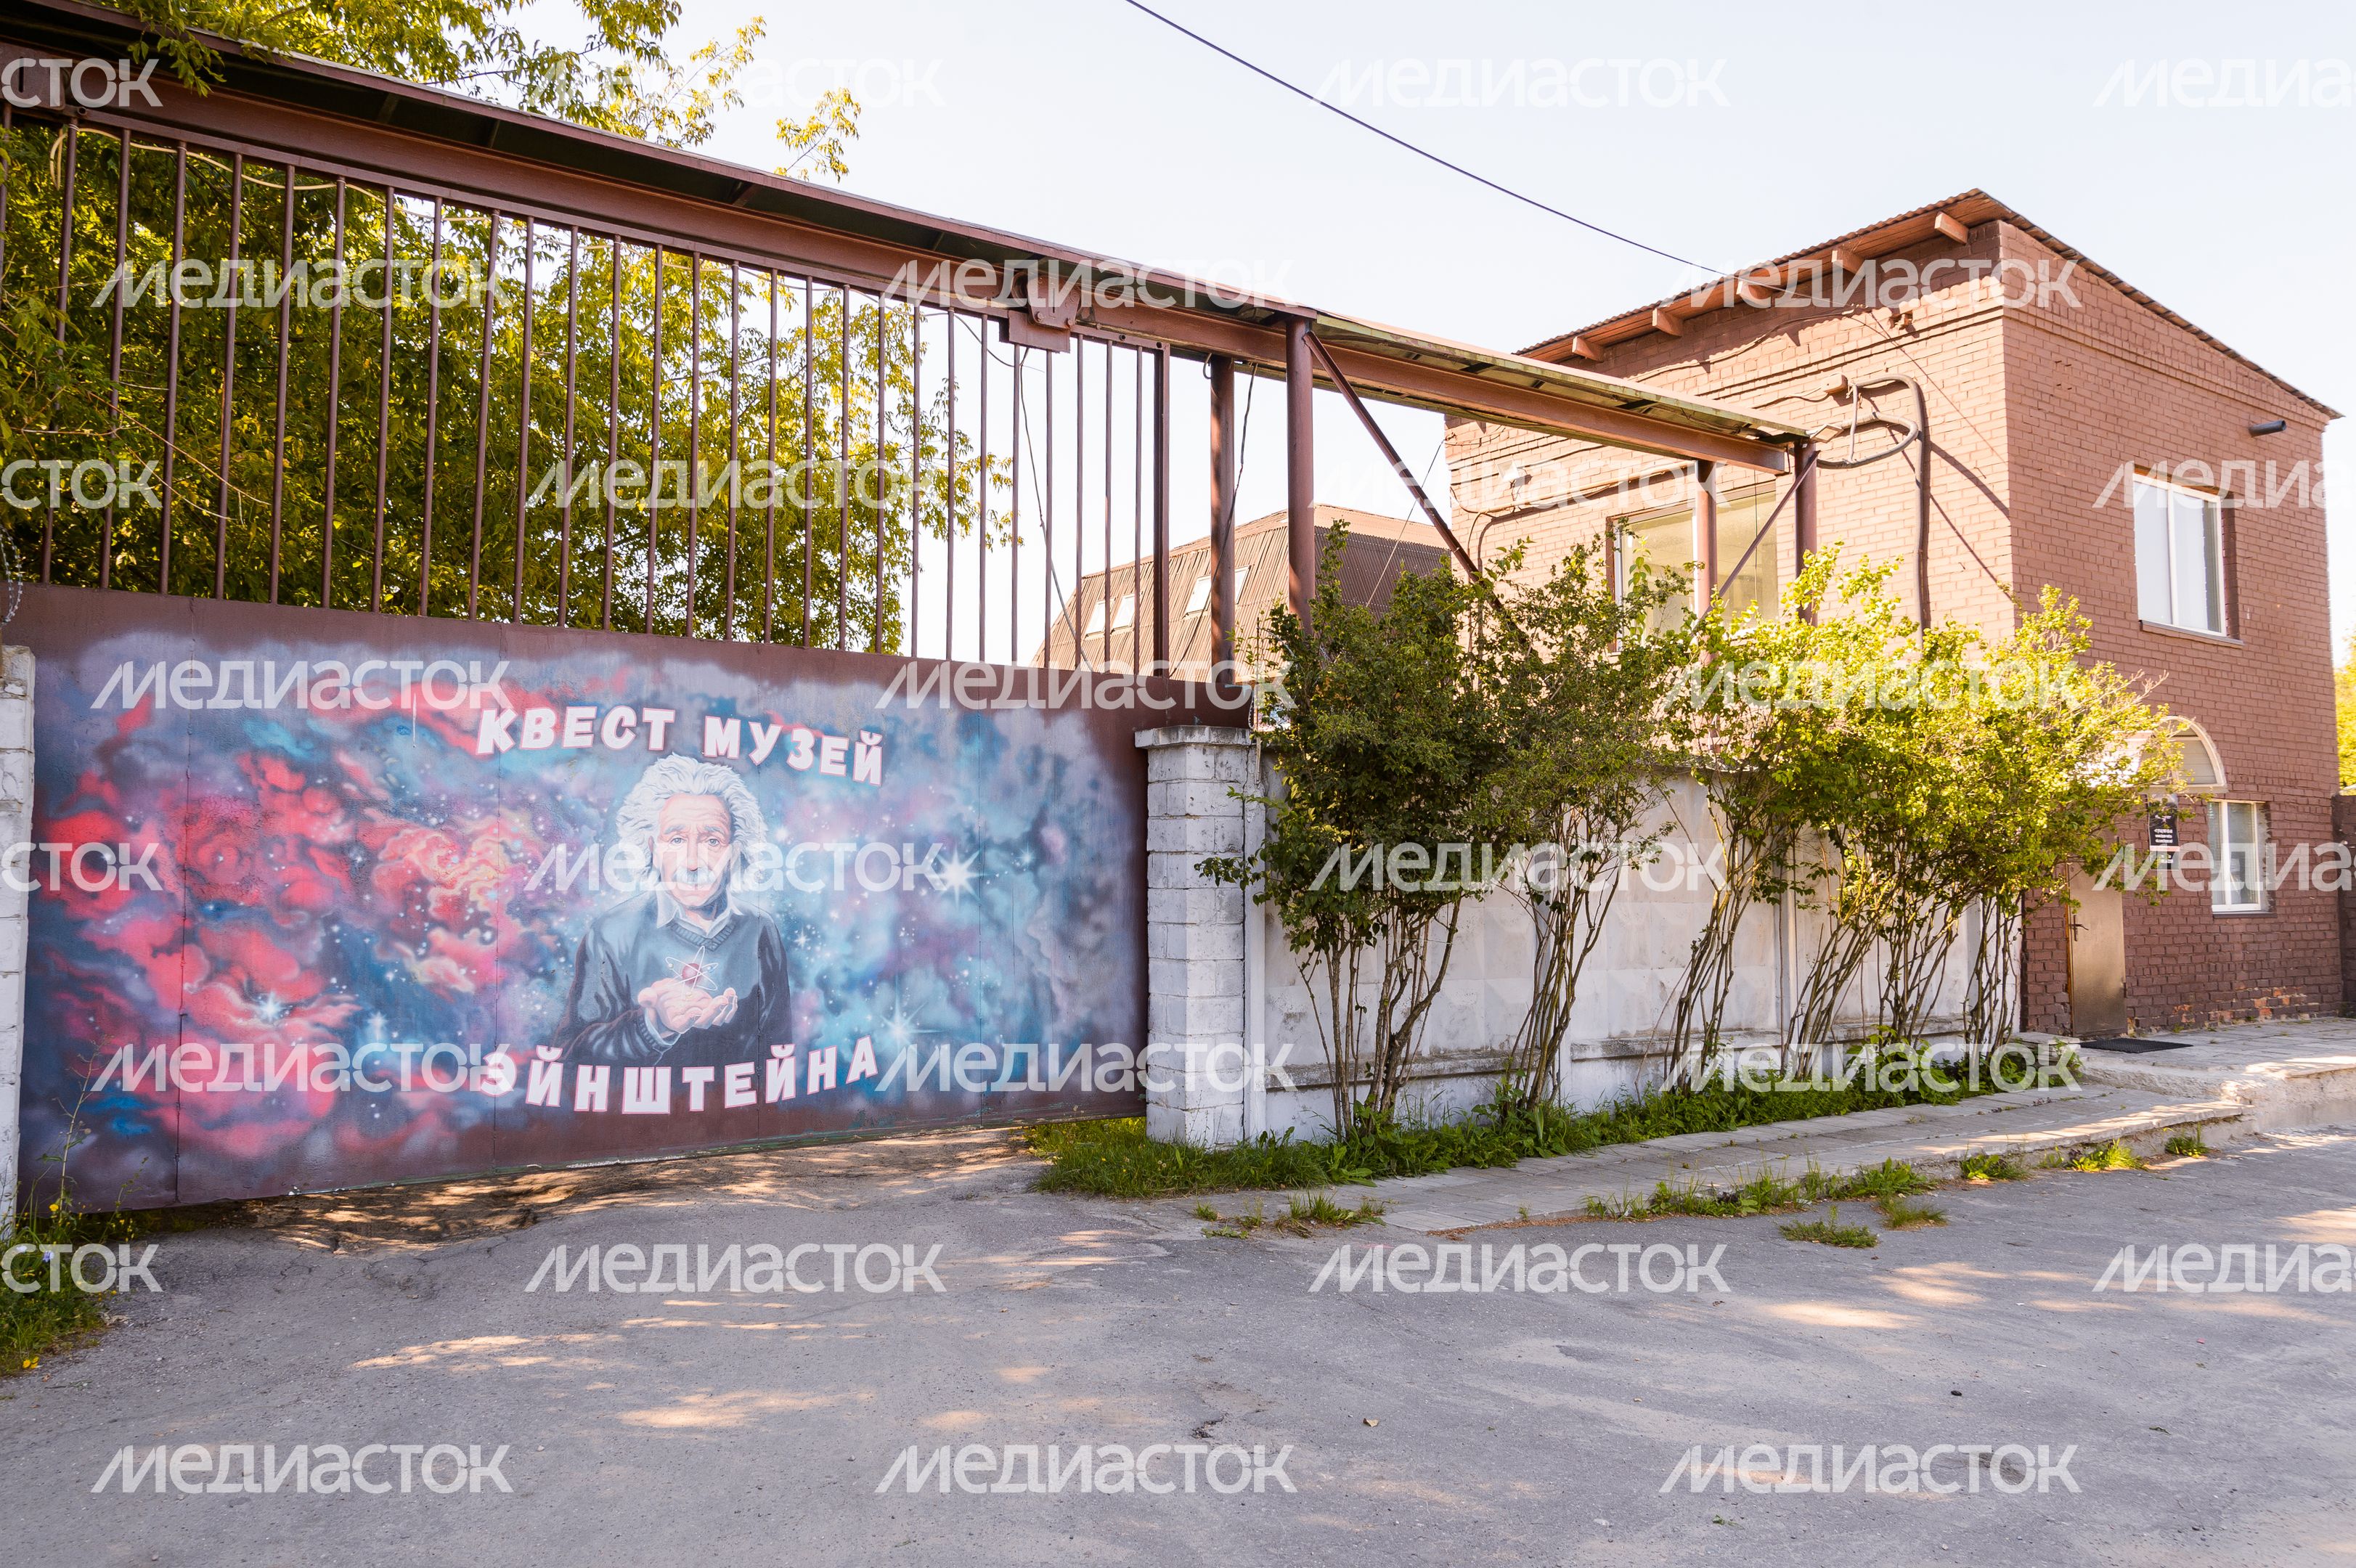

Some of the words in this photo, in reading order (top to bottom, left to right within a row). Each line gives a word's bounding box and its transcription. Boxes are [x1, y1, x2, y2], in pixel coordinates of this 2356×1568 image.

[476, 705, 675, 755] КВЕСТ
[704, 716, 883, 785] МУЗЕЙ
[481, 1035, 878, 1114] ЭЙНШТЕЙНА
